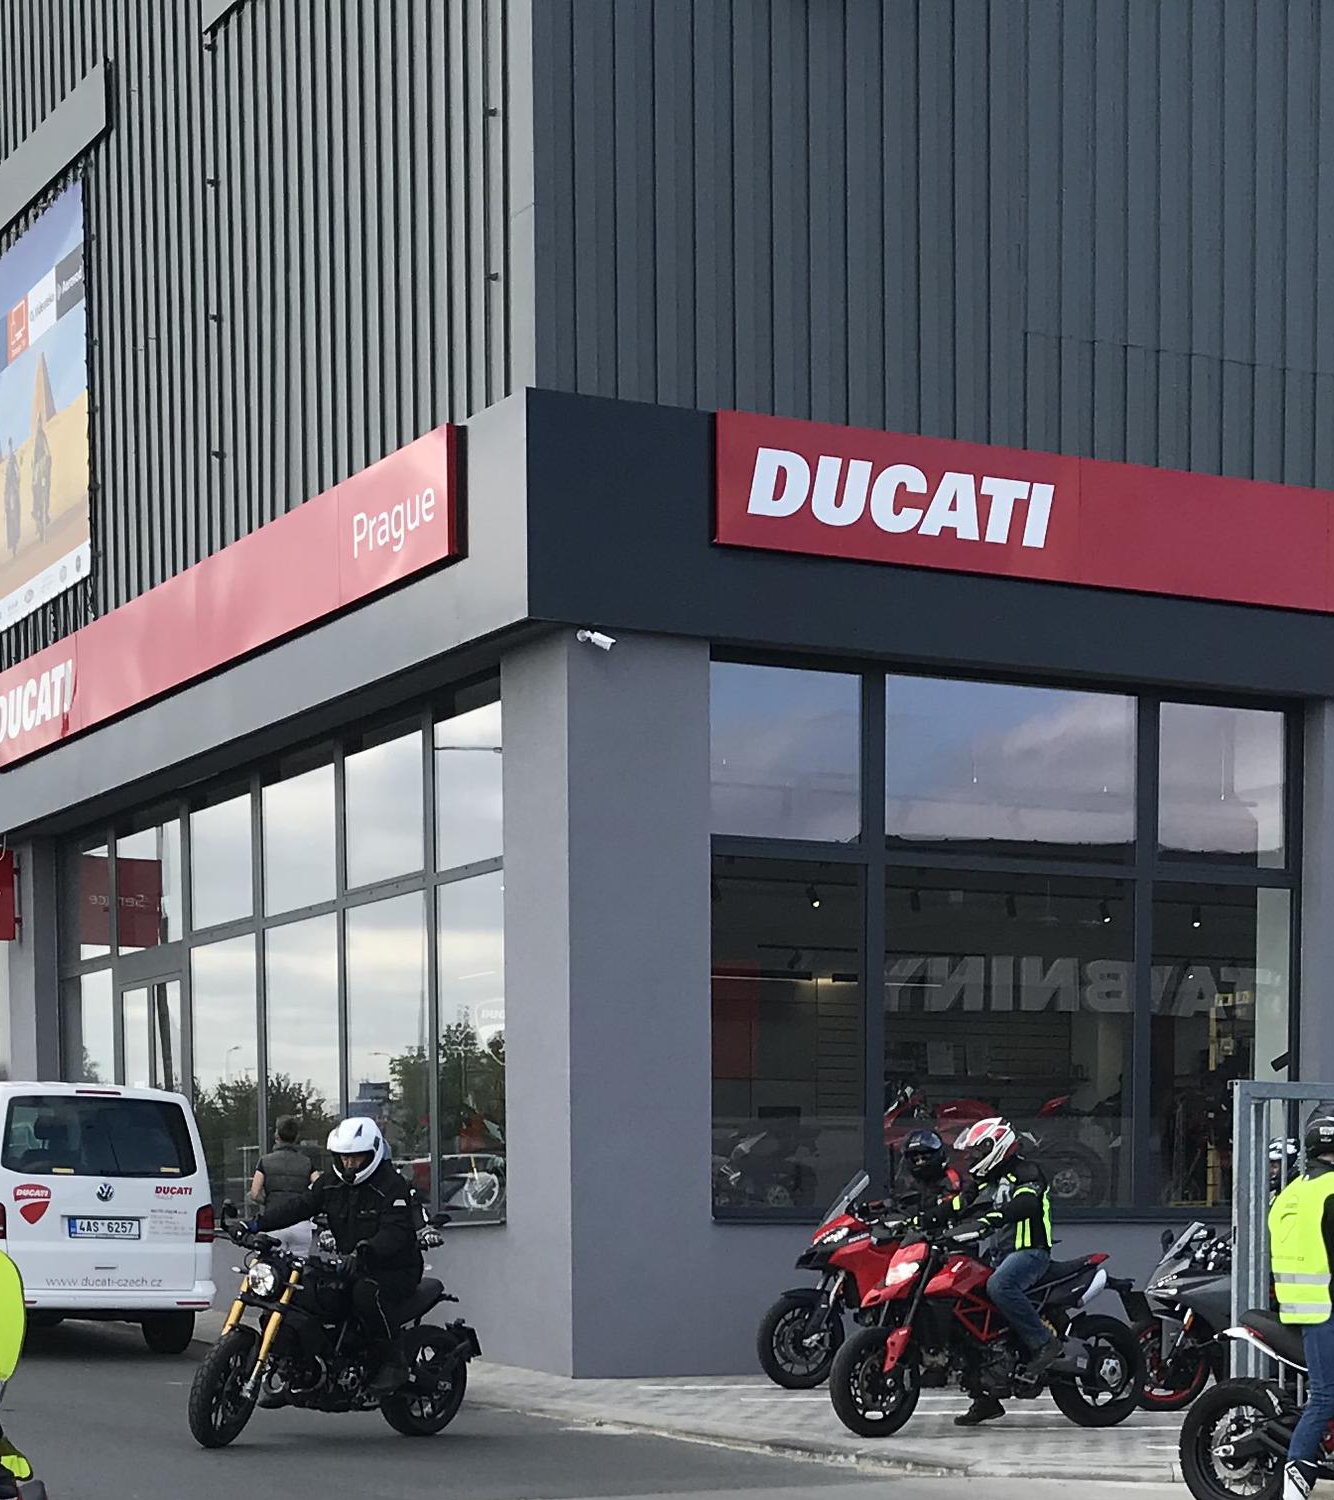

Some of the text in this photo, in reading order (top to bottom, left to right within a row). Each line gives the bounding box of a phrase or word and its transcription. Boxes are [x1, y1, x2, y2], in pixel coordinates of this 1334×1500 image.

[747, 447, 1055, 549] DUCATI
[352, 486, 436, 560] Prague
[16, 1188, 49, 1197] DUCATI
[155, 1185, 193, 1196] DUCATI
[79, 1222, 134, 1234] 4AS 6257
